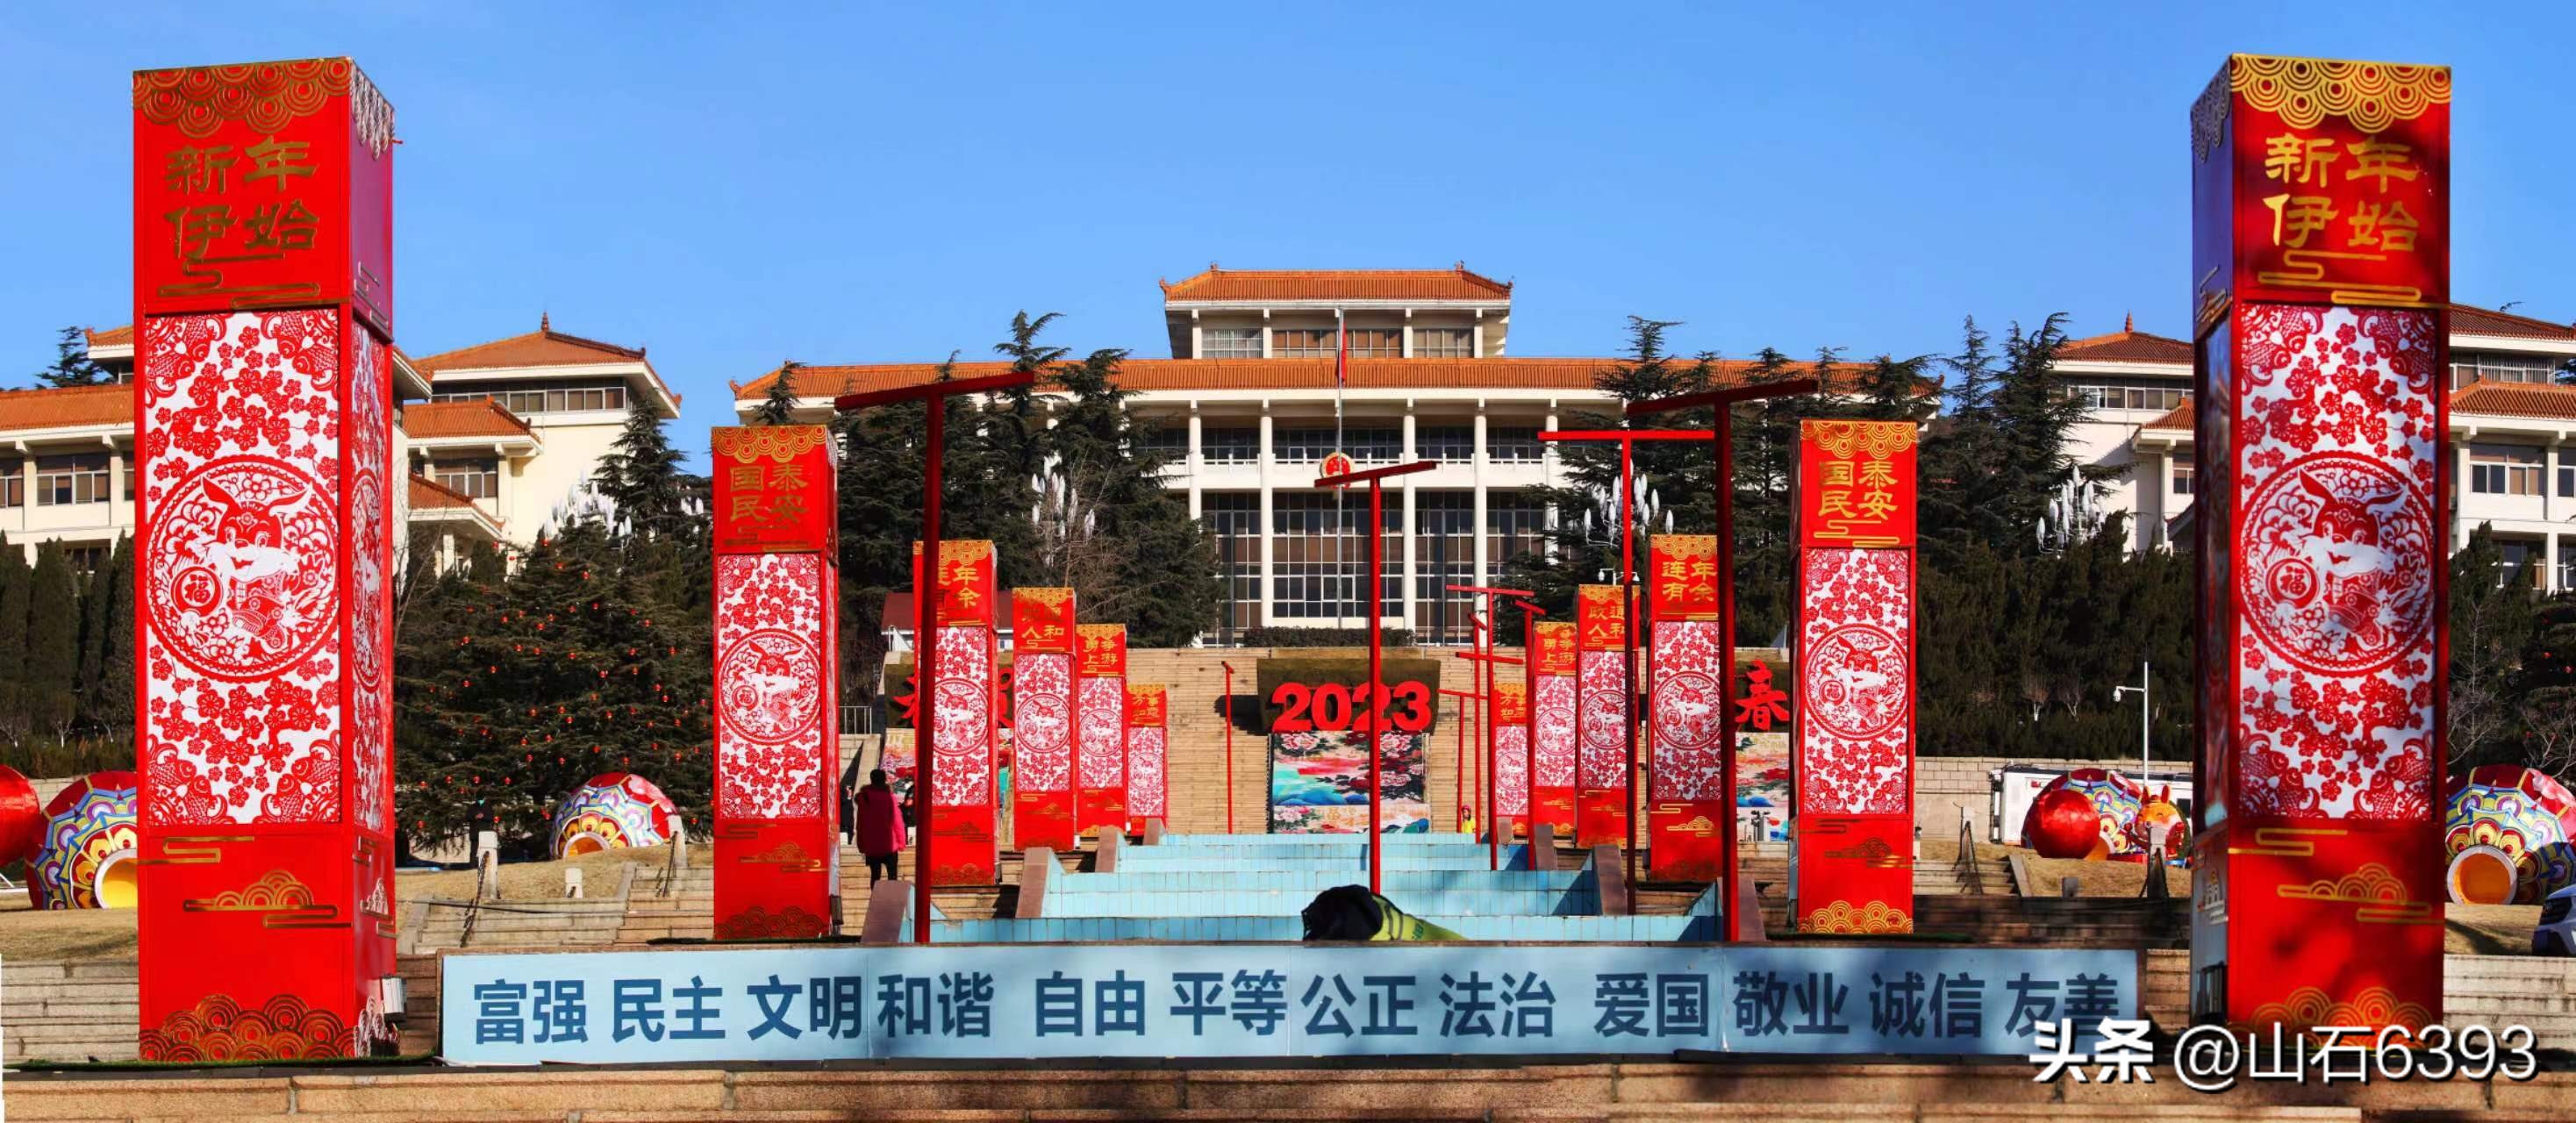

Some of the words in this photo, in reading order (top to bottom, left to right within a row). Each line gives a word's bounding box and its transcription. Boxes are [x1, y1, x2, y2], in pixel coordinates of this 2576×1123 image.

[165, 135, 319, 195] 新年
[2265, 133, 2419, 193] 新年
[163, 199, 320, 259] 伊始
[2263, 193, 2420, 252] 伊始
[730, 464, 808, 491] 国泰
[1819, 461, 1899, 489] 国泰
[730, 494, 808, 523] 民安
[1818, 490, 1899, 520] 民安
[1662, 561, 1717, 581] 连年
[2280, 565, 2305, 593] 福
[184, 573, 211, 602] 福
[1662, 583, 1717, 602] 有余
[1021, 625, 1064, 639] 人和
[1271, 681, 1433, 731] 2023
[1735, 659, 1790, 730] 春
[474, 979, 589, 1044] 富强
[612, 976, 726, 1042] 民主
[747, 975, 862, 1041] 文明
[877, 972, 994, 1038] 和谐
[1035, 970, 1146, 1037] 自由
[1170, 969, 1287, 1036] 平等
[1300, 973, 1418, 1038] 公正
[1439, 971, 1556, 1038] 法治
[1594, 972, 1708, 1037] 爱国
[1733, 970, 1849, 1037] 敬业
[1870, 971, 1986, 1038] 诚信
[2006, 972, 2119, 1038] 友善
